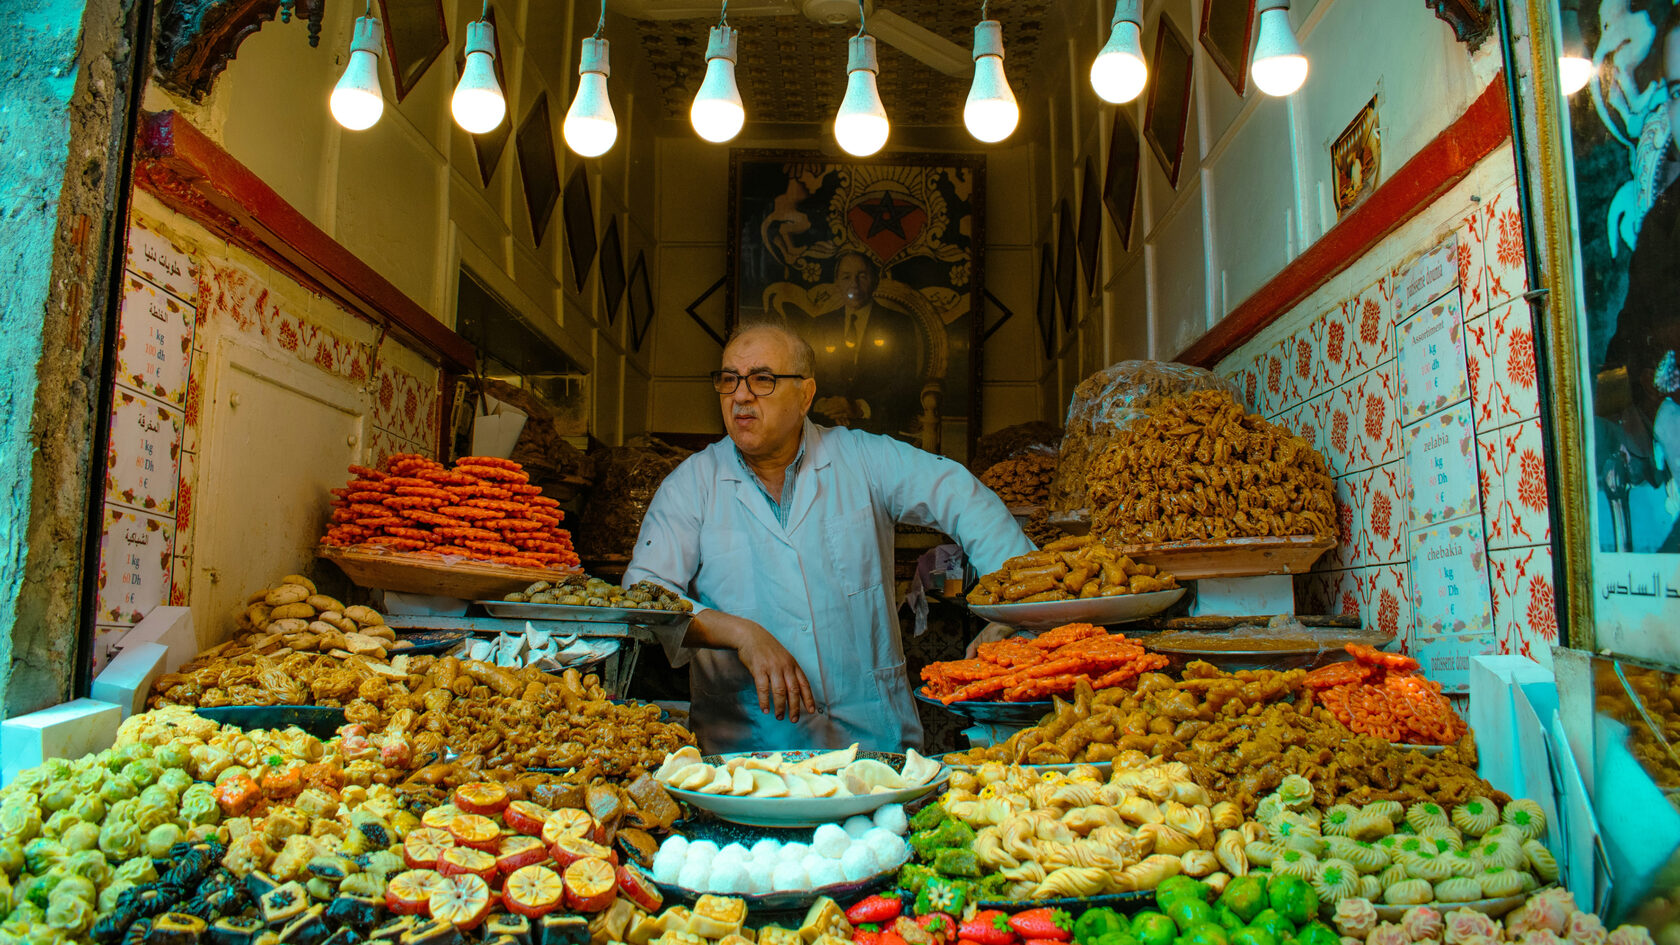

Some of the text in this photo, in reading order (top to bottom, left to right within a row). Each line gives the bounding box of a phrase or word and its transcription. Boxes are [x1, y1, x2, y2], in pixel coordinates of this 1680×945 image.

[158, 254, 181, 277] حلويات
[156, 328, 165, 346] kg
[1412, 320, 1444, 345] Assortiment
[145, 343, 166, 362] 100 dh
[1429, 343, 1437, 356] kg
[145, 439, 153, 456] kg
[1424, 431, 1449, 453] zelabia
[145, 459, 154, 472] Dh
[1434, 456, 1443, 470] kg
[1437, 472, 1448, 485] Dh
[125, 527, 149, 548] الشباكية
[1427, 542, 1463, 561] chebakia
[132, 554, 140, 570] kg
[131, 573, 142, 586] Dh
[1444, 566, 1454, 581] kg
[1447, 584, 1459, 597] Dh
[1601, 569, 1661, 600] السادس
[130, 593, 135, 604] €
